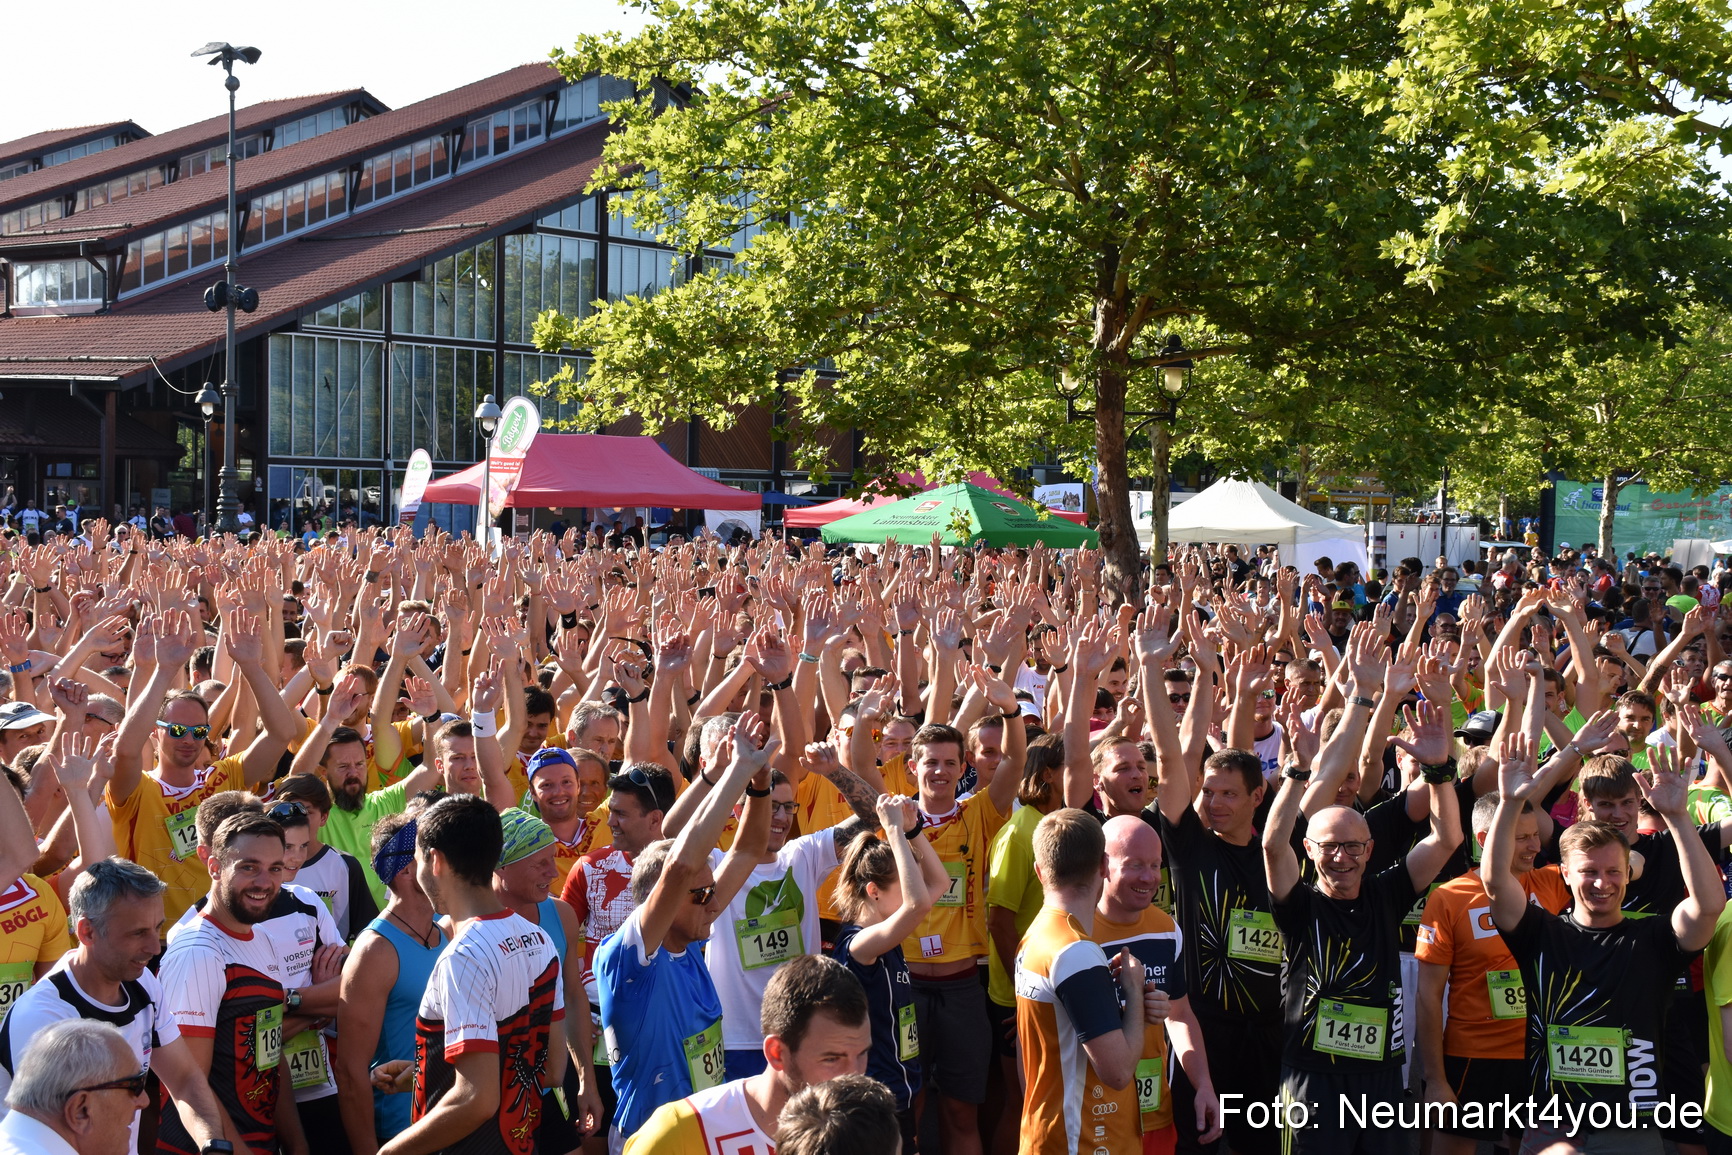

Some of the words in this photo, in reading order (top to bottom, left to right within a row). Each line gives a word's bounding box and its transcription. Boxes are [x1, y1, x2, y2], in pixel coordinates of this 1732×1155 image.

[503, 410, 523, 447] Bögerl
[873, 519, 941, 527] Lammsbräu
[0, 905, 49, 935] BÖGL
[753, 930, 789, 953] 149
[1238, 927, 1280, 950] 1422
[284, 948, 315, 963] VORSICH
[286, 959, 313, 972] Freilauf
[262, 1025, 282, 1052] 188
[1325, 1020, 1377, 1045] 1418
[1335, 1040, 1350, 1048] Fürst
[1350, 1042, 1365, 1050] Josef
[1556, 1045, 1613, 1068] 1420
[291, 1050, 319, 1072] 470
[702, 1043, 722, 1075] 818
[1559, 1065, 1587, 1073] Membarth
[1588, 1067, 1613, 1075] Günther
